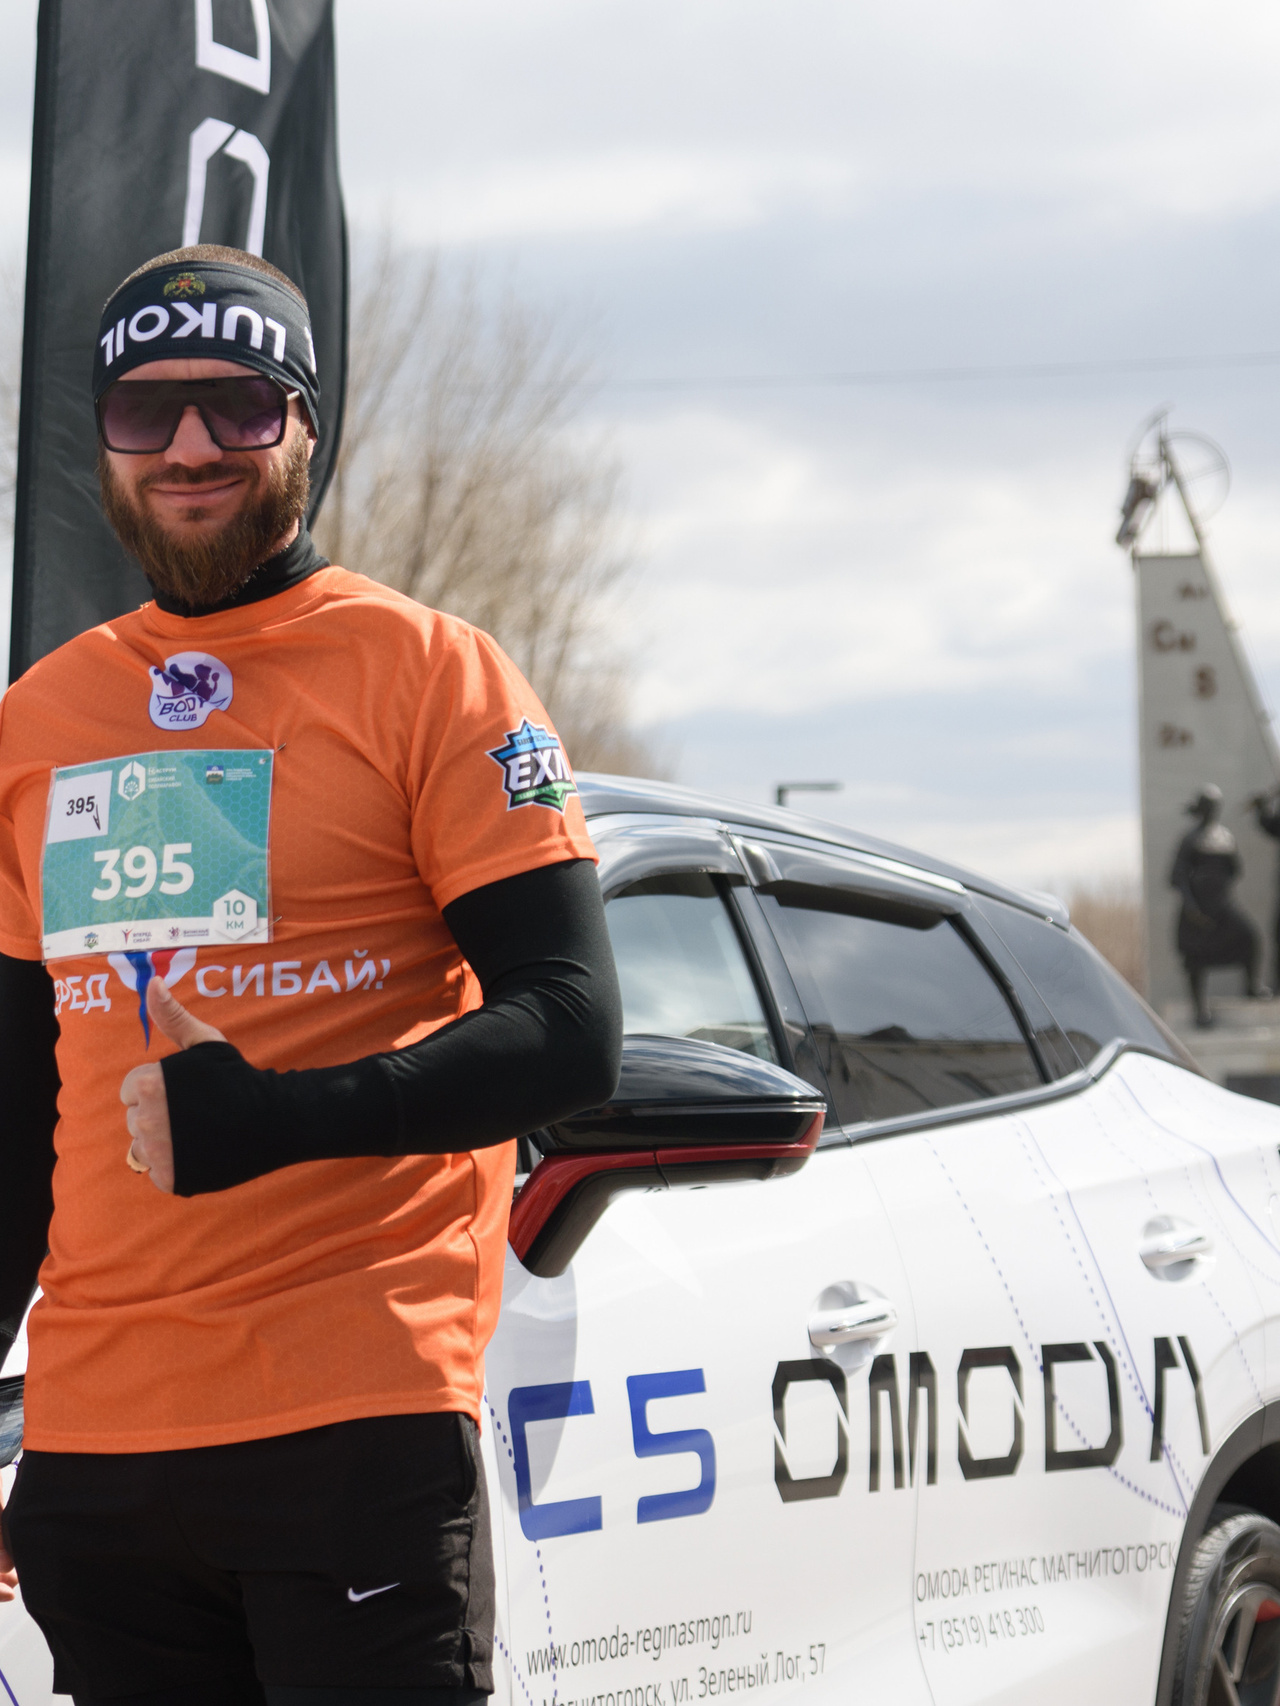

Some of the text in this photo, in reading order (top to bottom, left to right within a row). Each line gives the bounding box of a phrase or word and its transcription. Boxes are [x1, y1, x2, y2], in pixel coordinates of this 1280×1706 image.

[100, 301, 287, 367] LUKOIL
[169, 714, 198, 722] CLUB
[66, 795, 95, 816] 395
[91, 843, 195, 901] 395
[224, 900, 246, 916] 10
[195, 949, 391, 998] СИБАЙ!
[507, 1367, 717, 1542] C5
[974, 1557, 1039, 1594] РЕГИНАС
[1042, 1541, 1178, 1584] МАГНИТОГОРСК
[920, 1605, 1045, 1654] +7 (3519) 418 300
[670, 1677, 693, 1705] ул.
[698, 1652, 770, 1699] Зеленый
[773, 1650, 806, 1684] Лог,
[809, 1642, 827, 1677] 57
